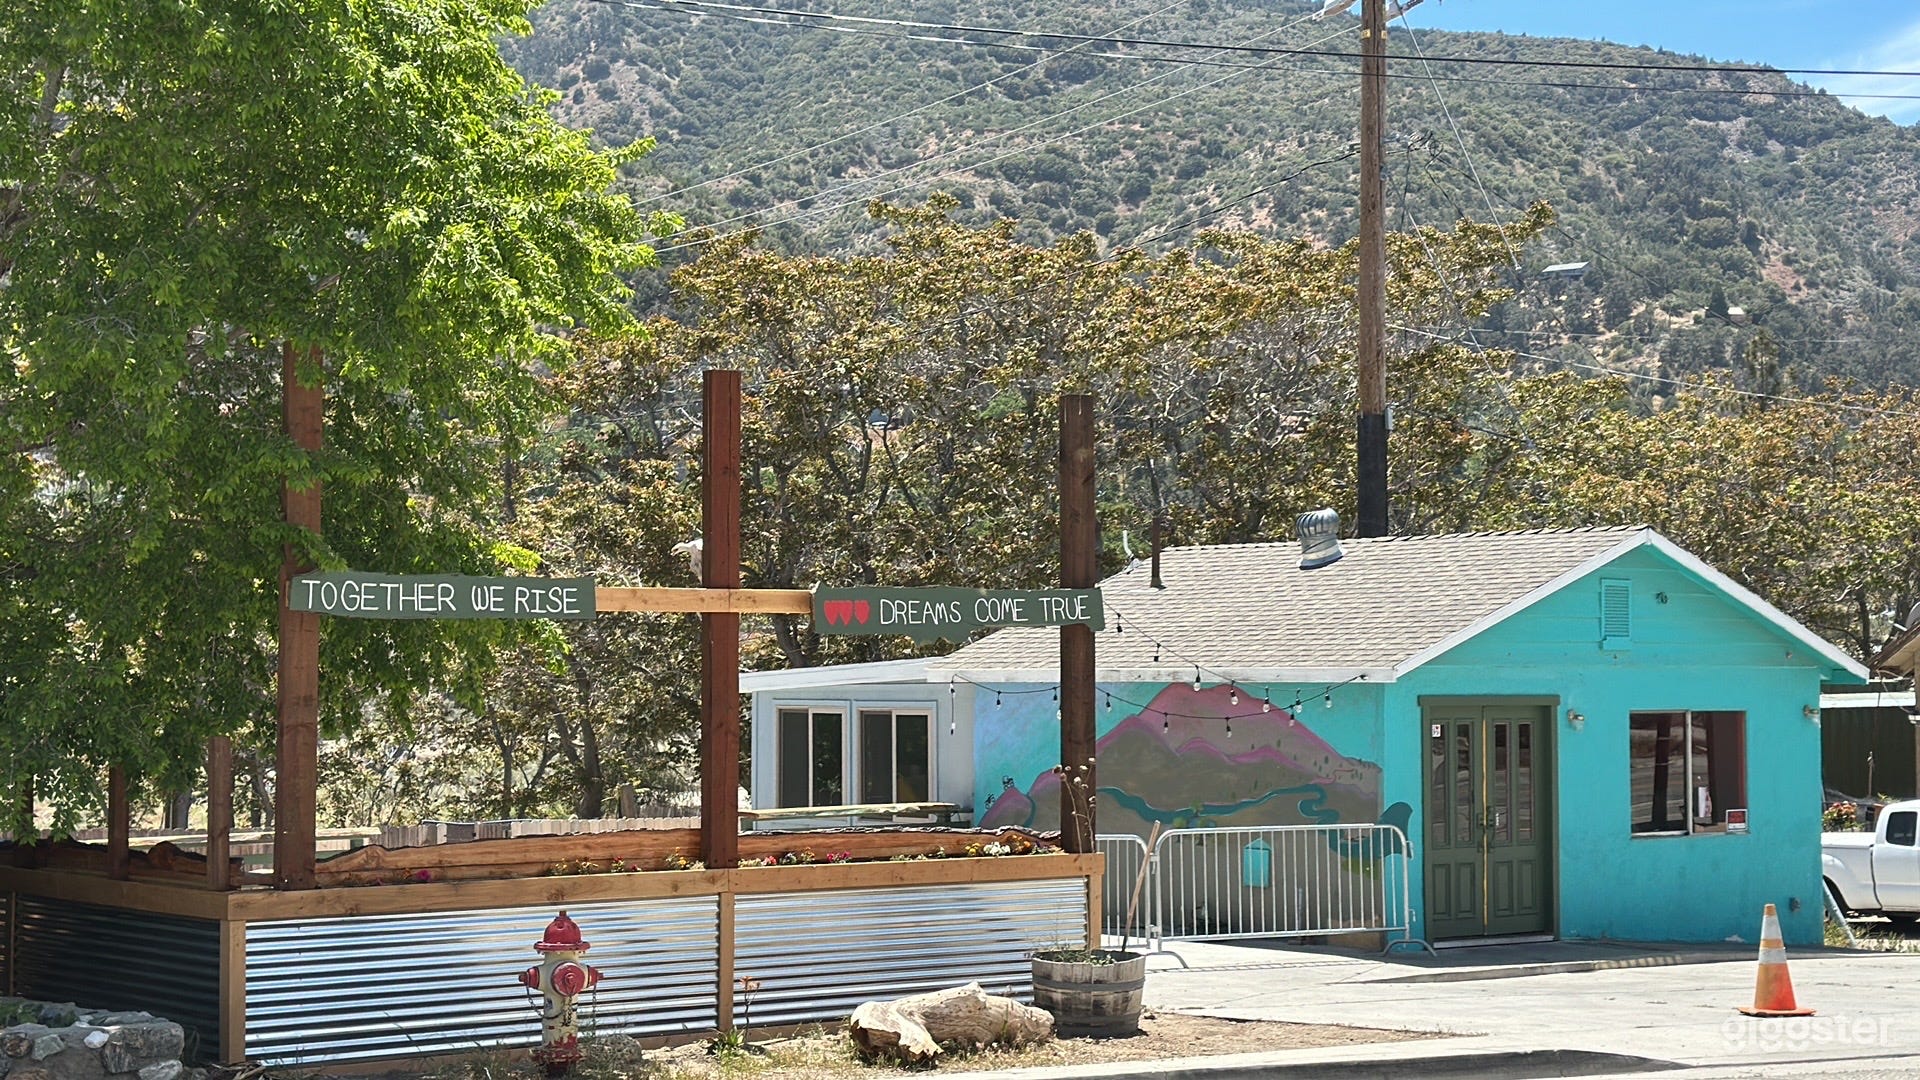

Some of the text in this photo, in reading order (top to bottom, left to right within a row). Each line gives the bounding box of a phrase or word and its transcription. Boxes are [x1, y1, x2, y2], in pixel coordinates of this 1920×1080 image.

[301, 580, 581, 614] TOGETHER WE RISE
[880, 594, 1091, 626] DREAMS COME TRUE
